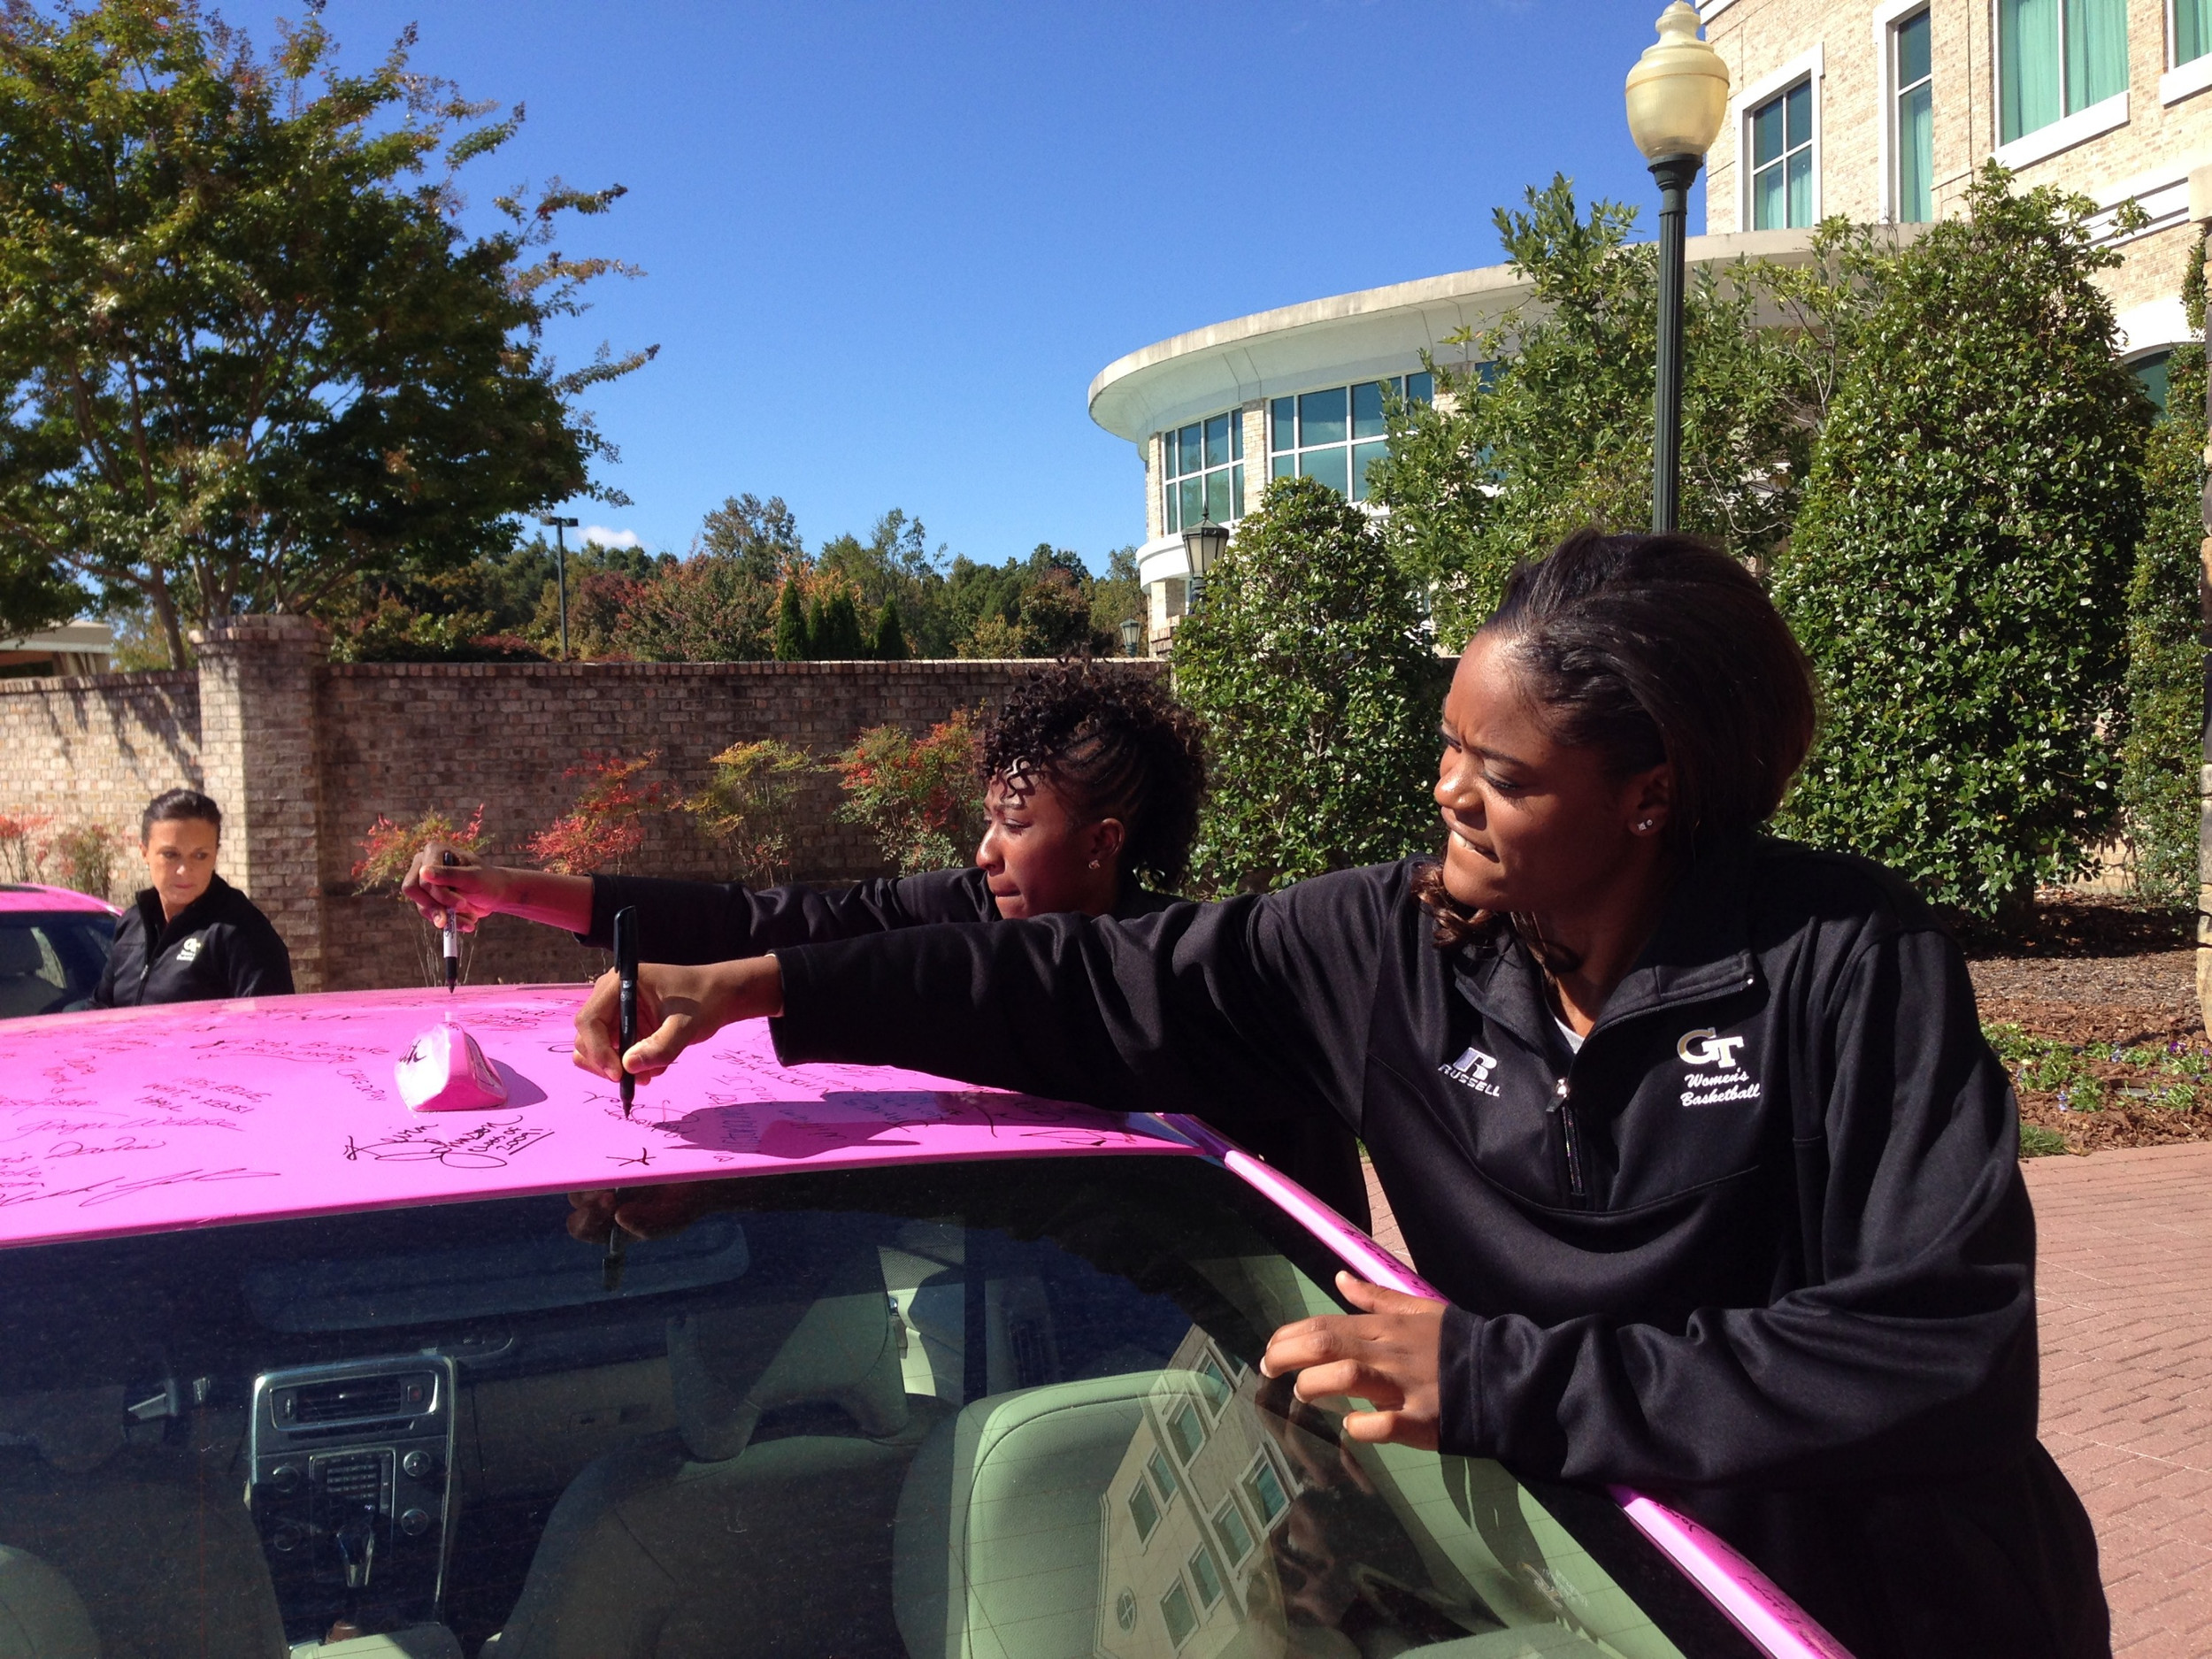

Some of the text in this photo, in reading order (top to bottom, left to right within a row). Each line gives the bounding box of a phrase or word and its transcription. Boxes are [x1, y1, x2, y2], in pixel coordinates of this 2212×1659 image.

[1677, 1026, 1745, 1069] GT
[1438, 1063, 1501, 1097] RUSSELL
[1684, 1066, 1750, 1088] Women's
[1680, 1083, 1761, 1107] Basketball
